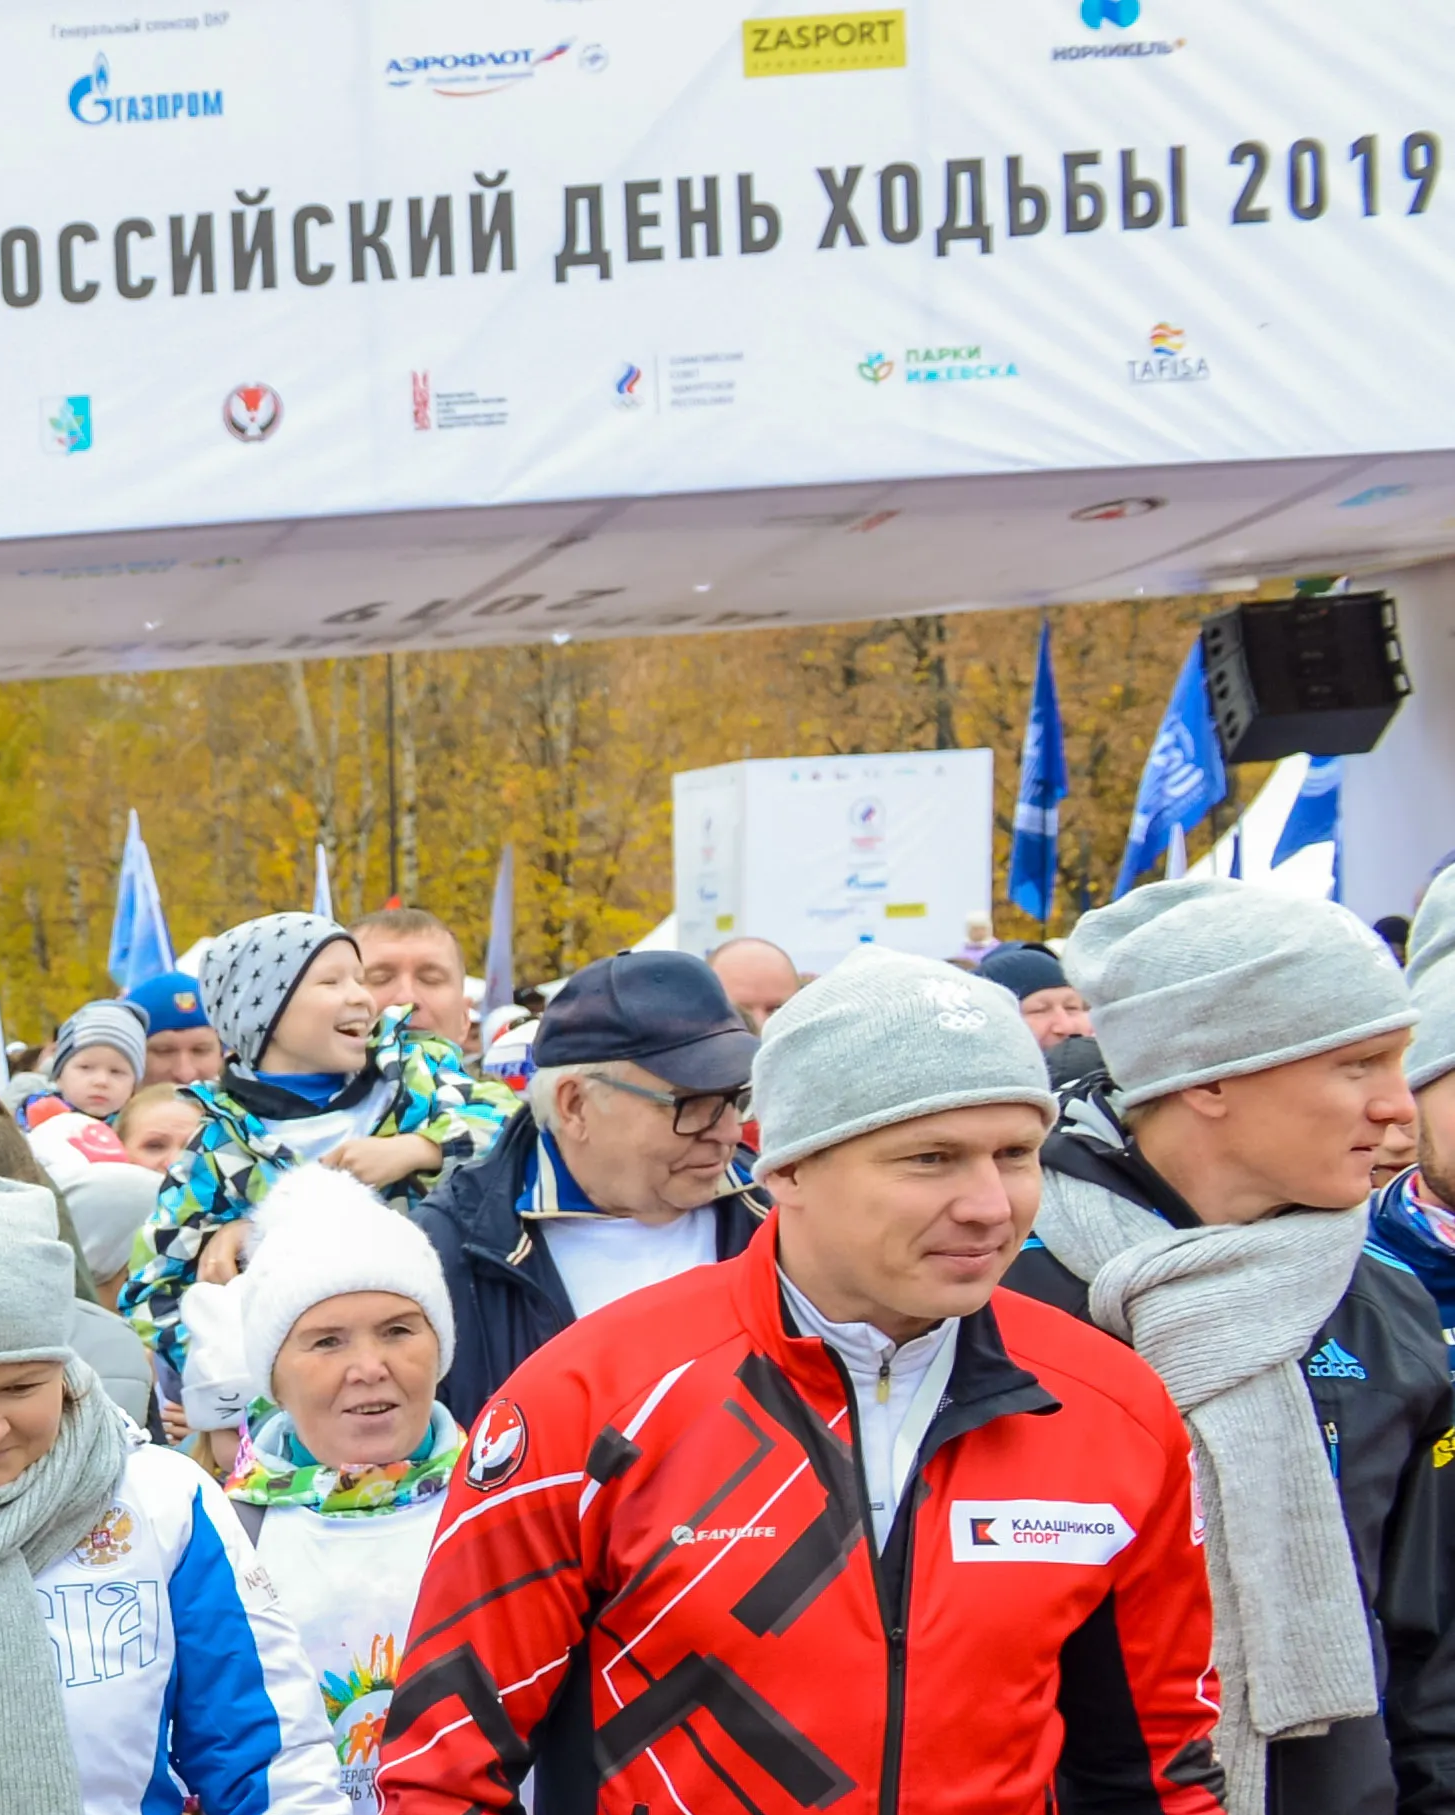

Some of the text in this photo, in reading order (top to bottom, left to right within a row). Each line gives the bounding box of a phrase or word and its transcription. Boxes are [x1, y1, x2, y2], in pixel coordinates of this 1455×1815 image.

[752, 20, 896, 52] ZASPORT
[386, 48, 534, 72] АЭРОФЛОТ
[1052, 41, 1174, 61] НОРНИКЕЛЬ
[117, 90, 223, 123] ГАЗПРОМ
[555, 171, 781, 283] ДЕНЬ
[816, 144, 1187, 257] ХОДЬБЫ
[1228, 129, 1441, 225] 2019
[906, 346, 982, 364] ПАРКИ
[1128, 357, 1210, 382] TAFISA
[1308, 1364, 1366, 1380] adidas
[696, 1526, 776, 1541] FANLIFE
[1012, 1519, 1115, 1535] КАЛАШНИКОВ
[1013, 1532, 1060, 1544] СПОРТ
